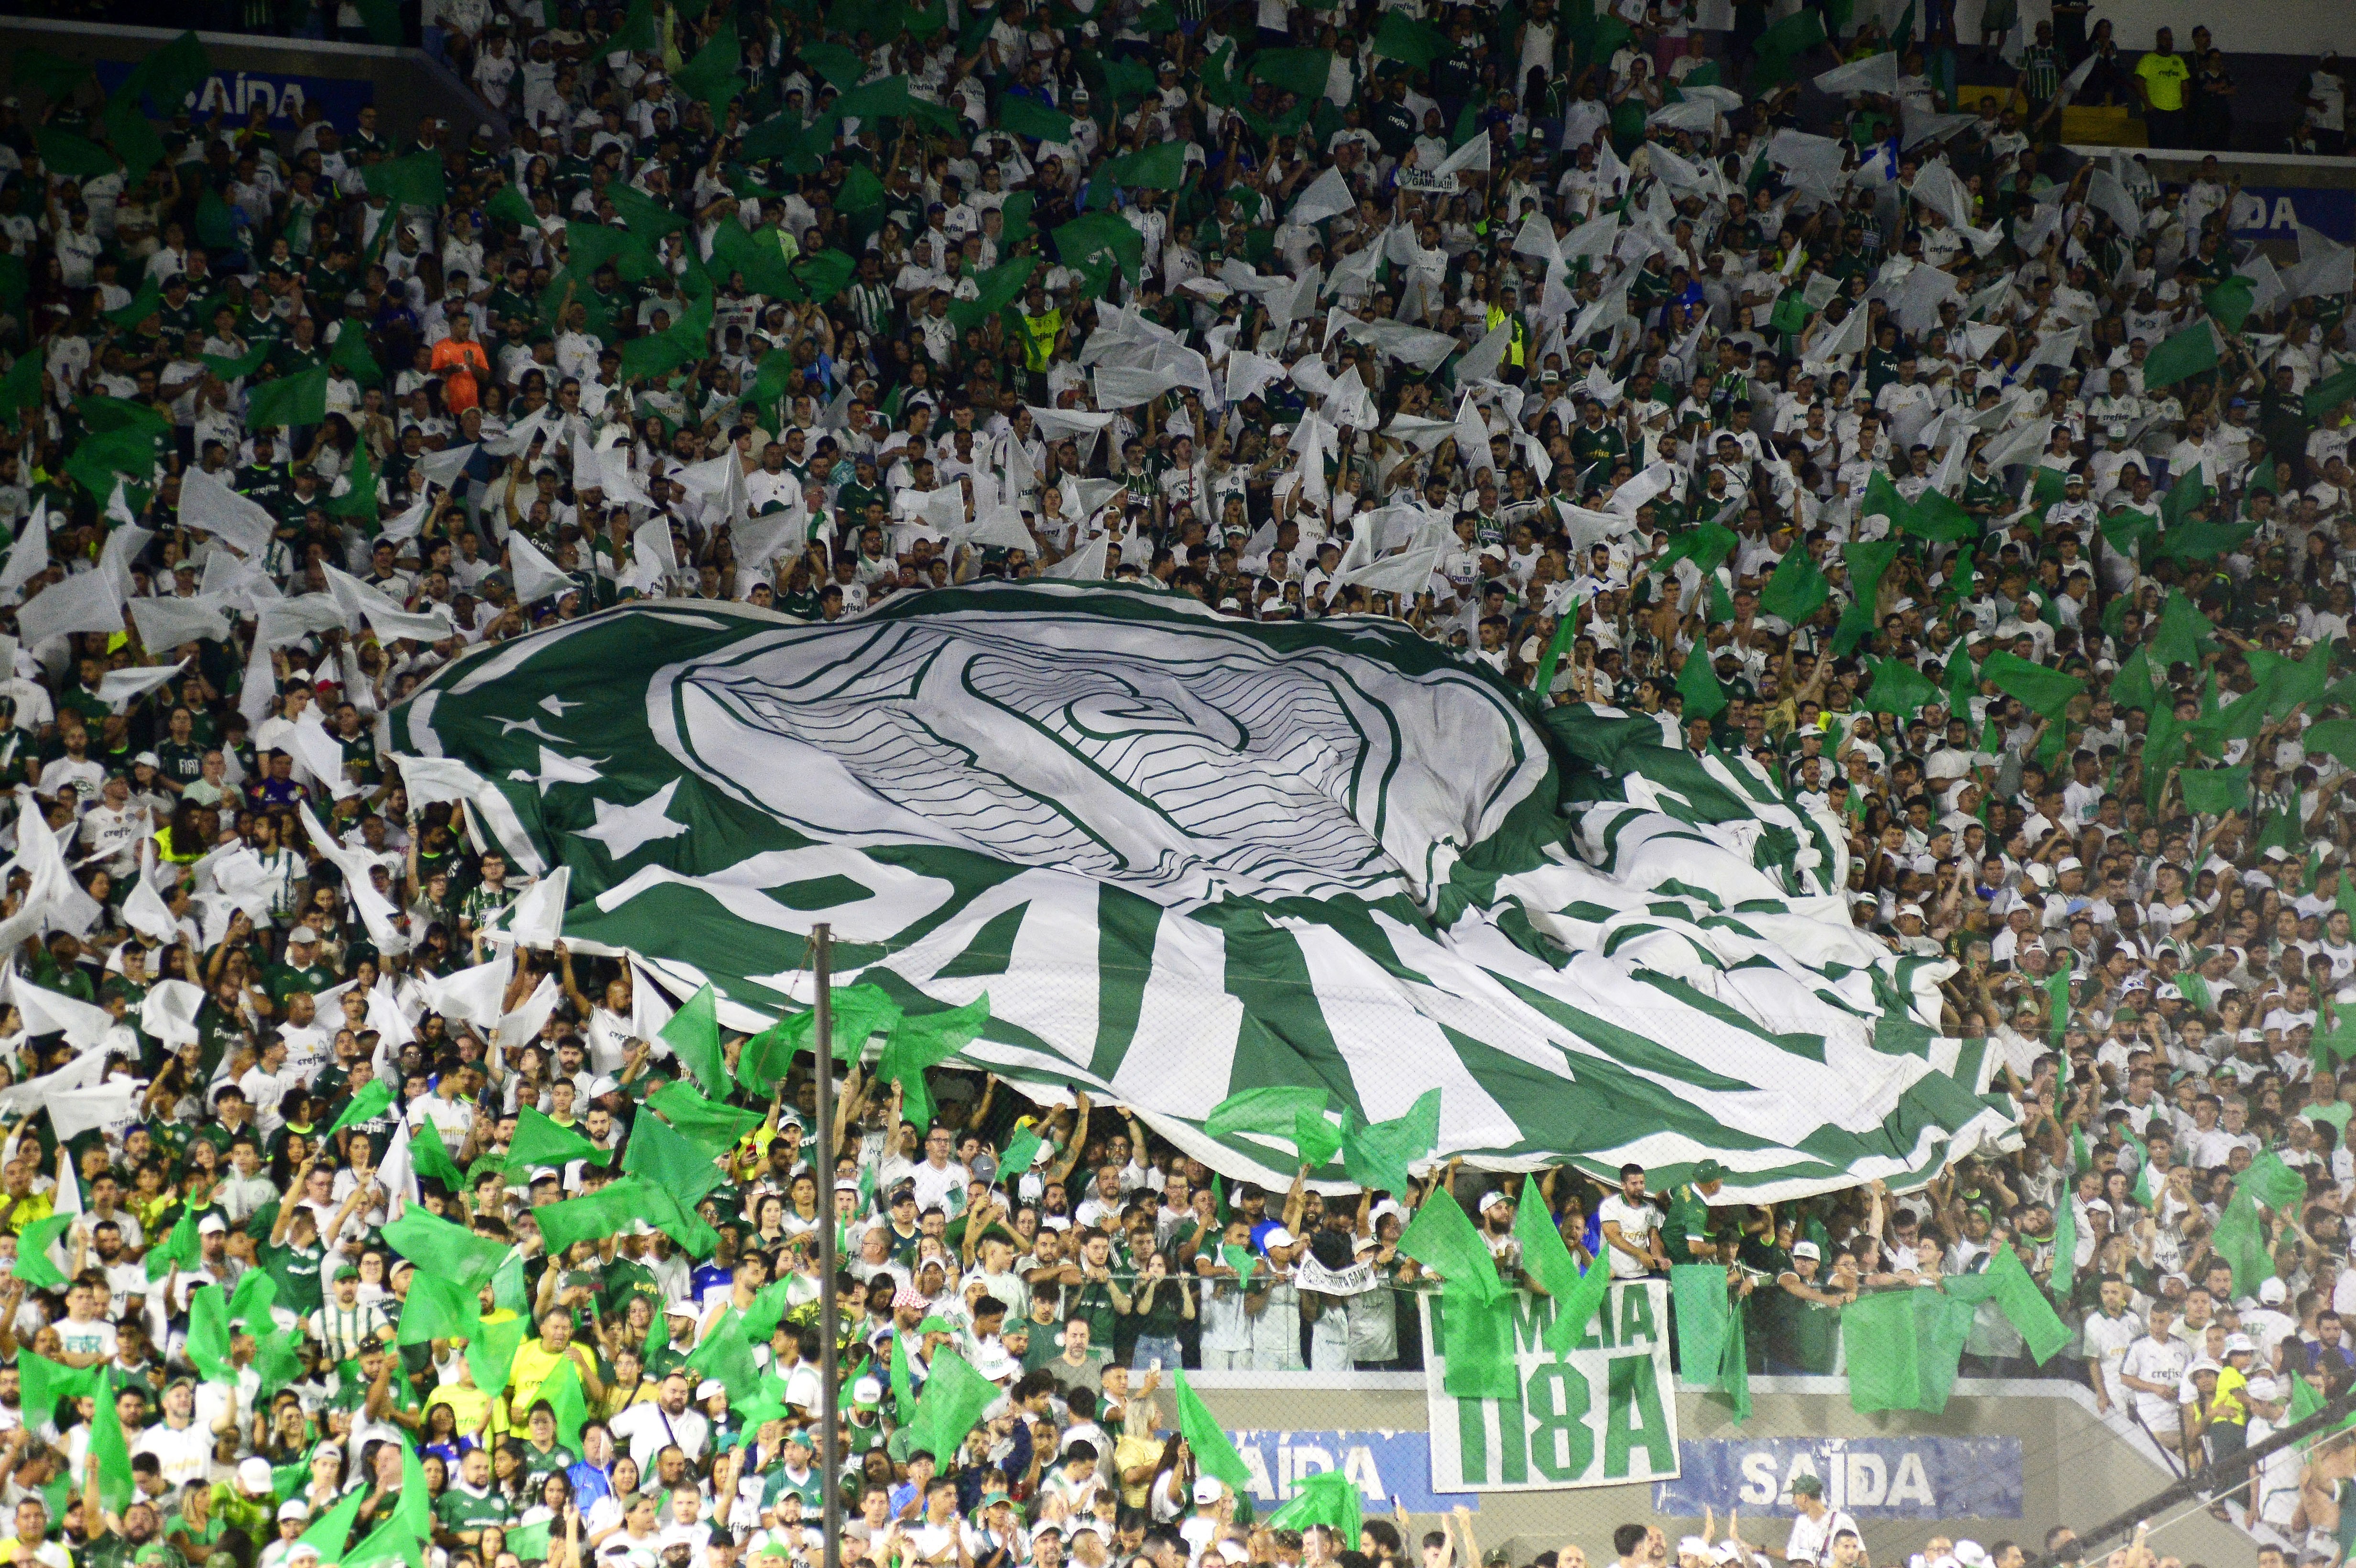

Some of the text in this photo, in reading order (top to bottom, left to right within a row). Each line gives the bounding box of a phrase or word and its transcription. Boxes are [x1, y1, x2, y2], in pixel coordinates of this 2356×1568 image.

[184, 71, 305, 119] AÍDA
[1412, 177, 1452, 189] GAMA!!!
[943, 224, 963, 233] efisa
[1930, 245, 1952, 254] crefisa
[1041, 528, 1059, 536] cref
[1451, 575, 1476, 583] parma
[840, 602, 861, 613] efisa
[1240, 1430, 1386, 1501] AÍDA
[1739, 1438, 1936, 1506] SAÍDA
